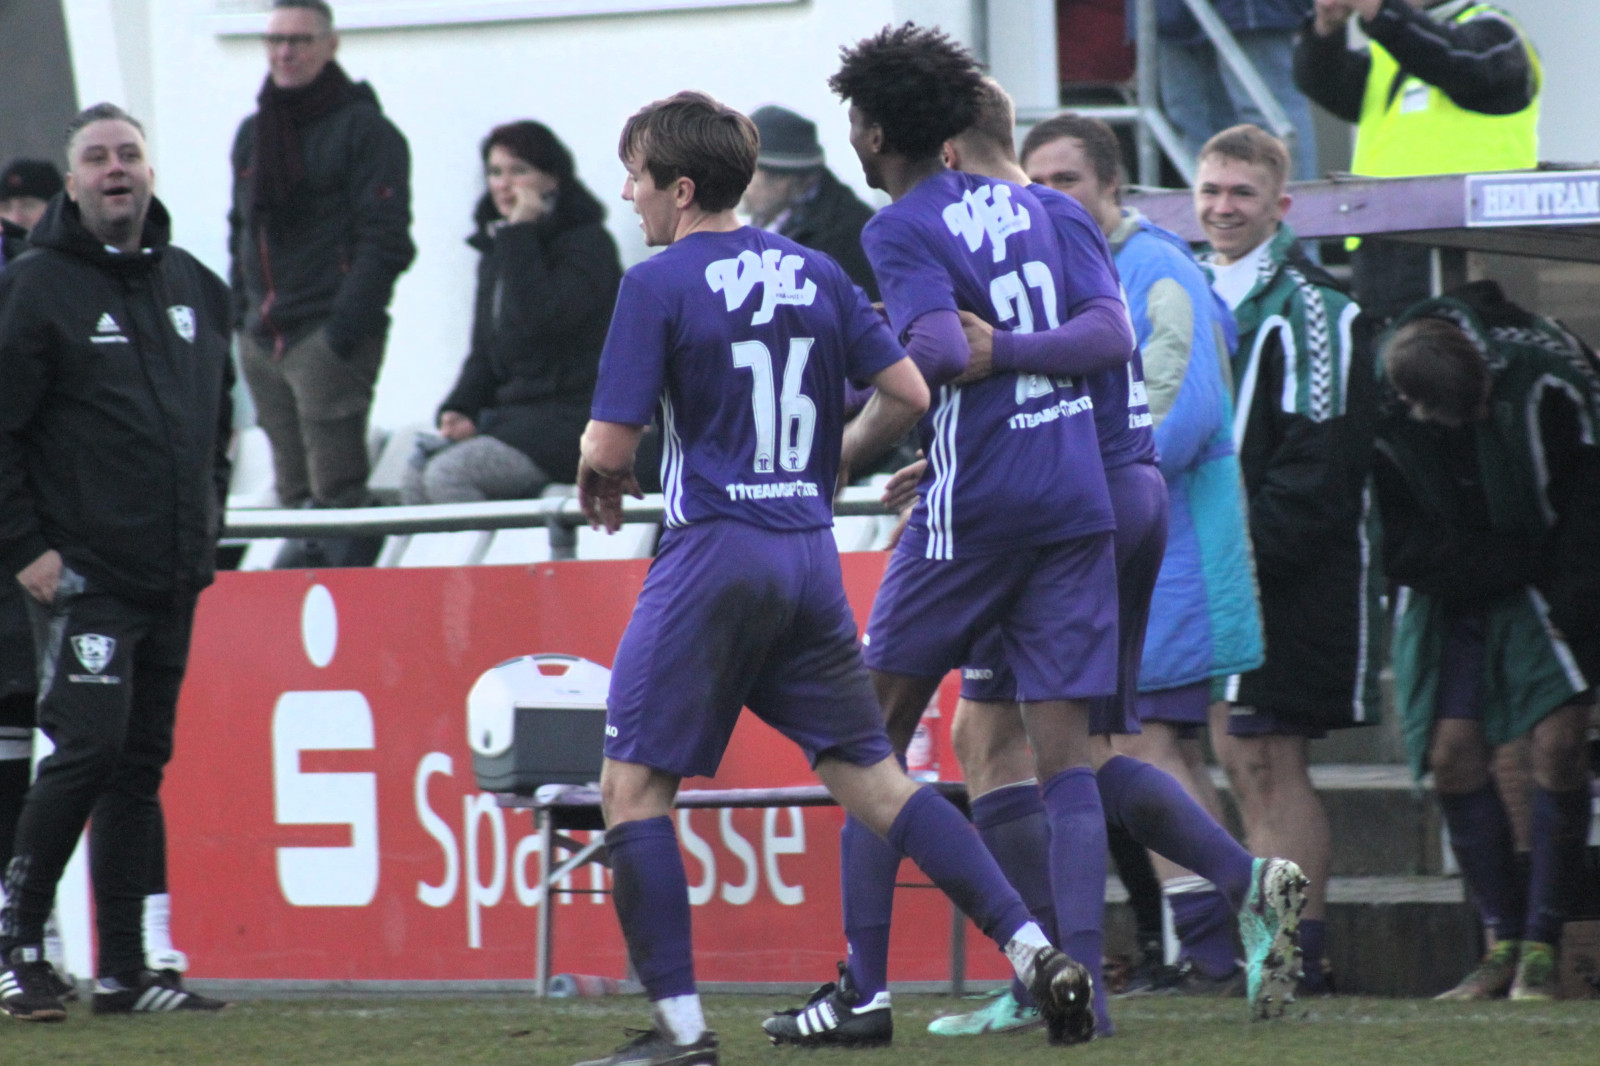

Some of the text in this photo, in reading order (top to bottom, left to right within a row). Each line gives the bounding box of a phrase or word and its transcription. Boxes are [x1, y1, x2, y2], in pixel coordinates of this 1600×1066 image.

[1483, 181, 1600, 217] HEIMTEAM
[731, 337, 815, 473] 16
[415, 752, 806, 948] Spasse
